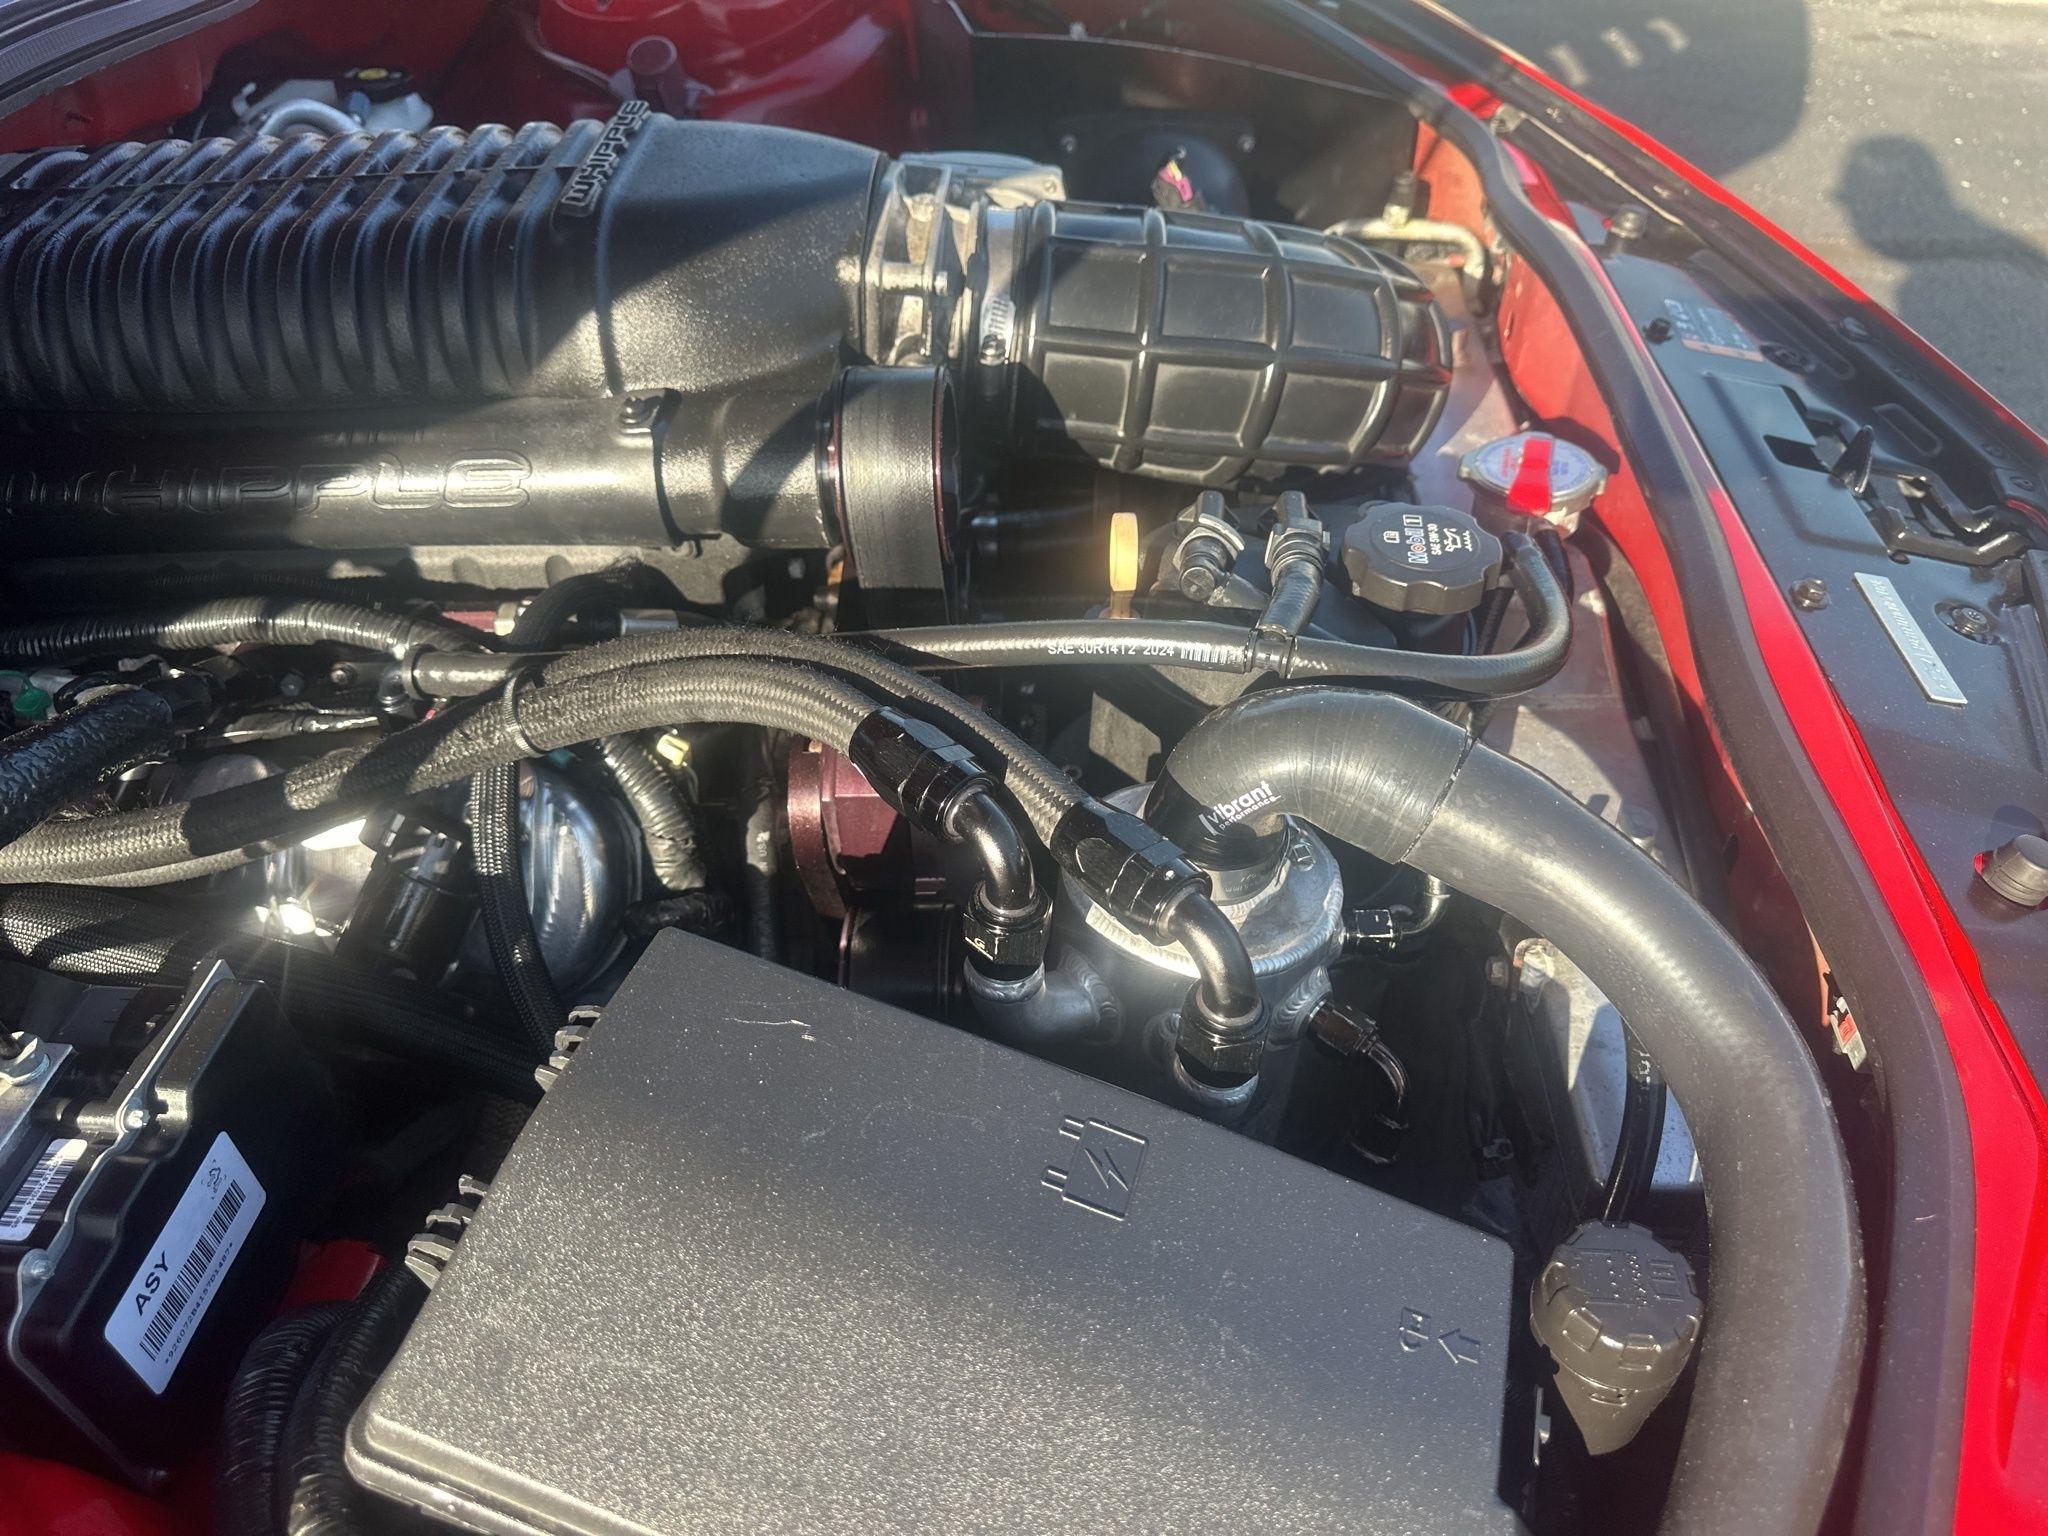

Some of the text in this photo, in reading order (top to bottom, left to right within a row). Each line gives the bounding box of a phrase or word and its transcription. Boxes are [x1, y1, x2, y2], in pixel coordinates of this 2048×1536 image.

[561, 100, 650, 207] WHIPPLE
[1403, 514, 1429, 564] Mobil 1
[1430, 542, 1442, 556] SAE
[1047, 641, 1075, 655] SAE
[1142, 641, 1175, 657] 2024
[1218, 794, 1281, 830] performance
[135, 1251, 169, 1317] ASY
